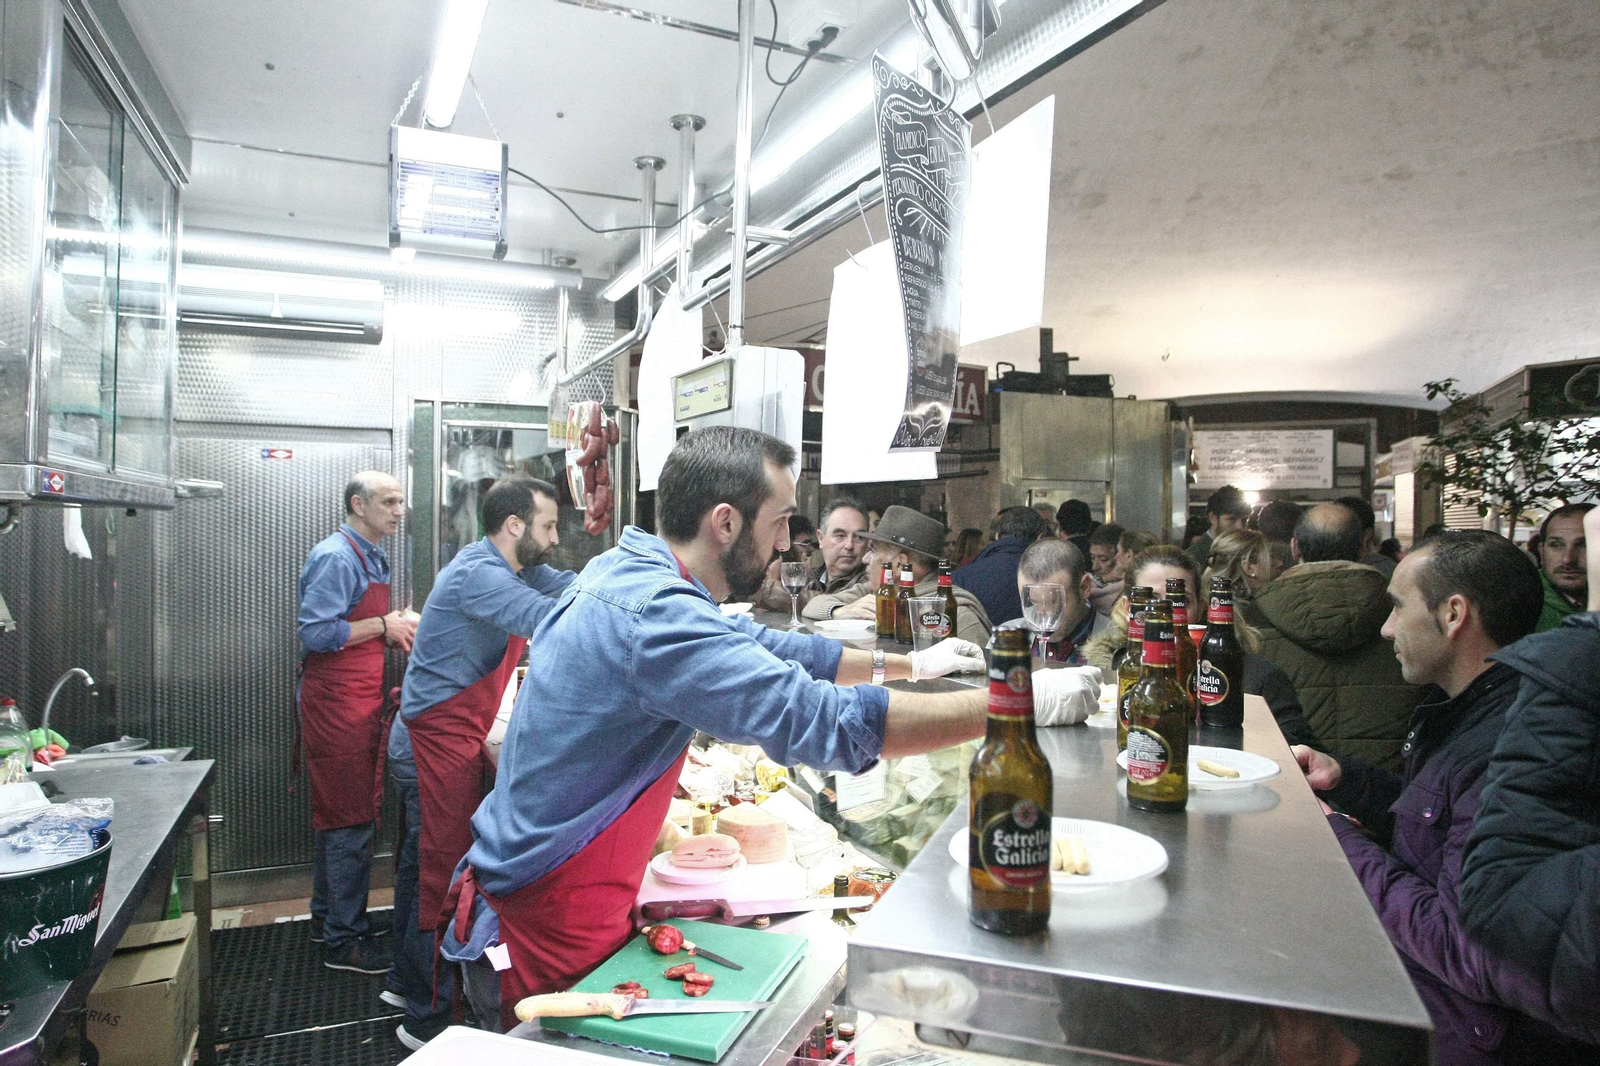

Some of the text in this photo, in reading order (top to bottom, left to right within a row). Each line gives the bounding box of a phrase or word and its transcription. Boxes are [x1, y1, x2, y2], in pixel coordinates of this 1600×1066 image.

[896, 130, 926, 150] FLAMENCO
[901, 233, 935, 267] BEBIDAS
[904, 273, 928, 290] REFRESCO
[995, 846, 1048, 865] Galicia
[18, 902, 101, 946] San Miguel
